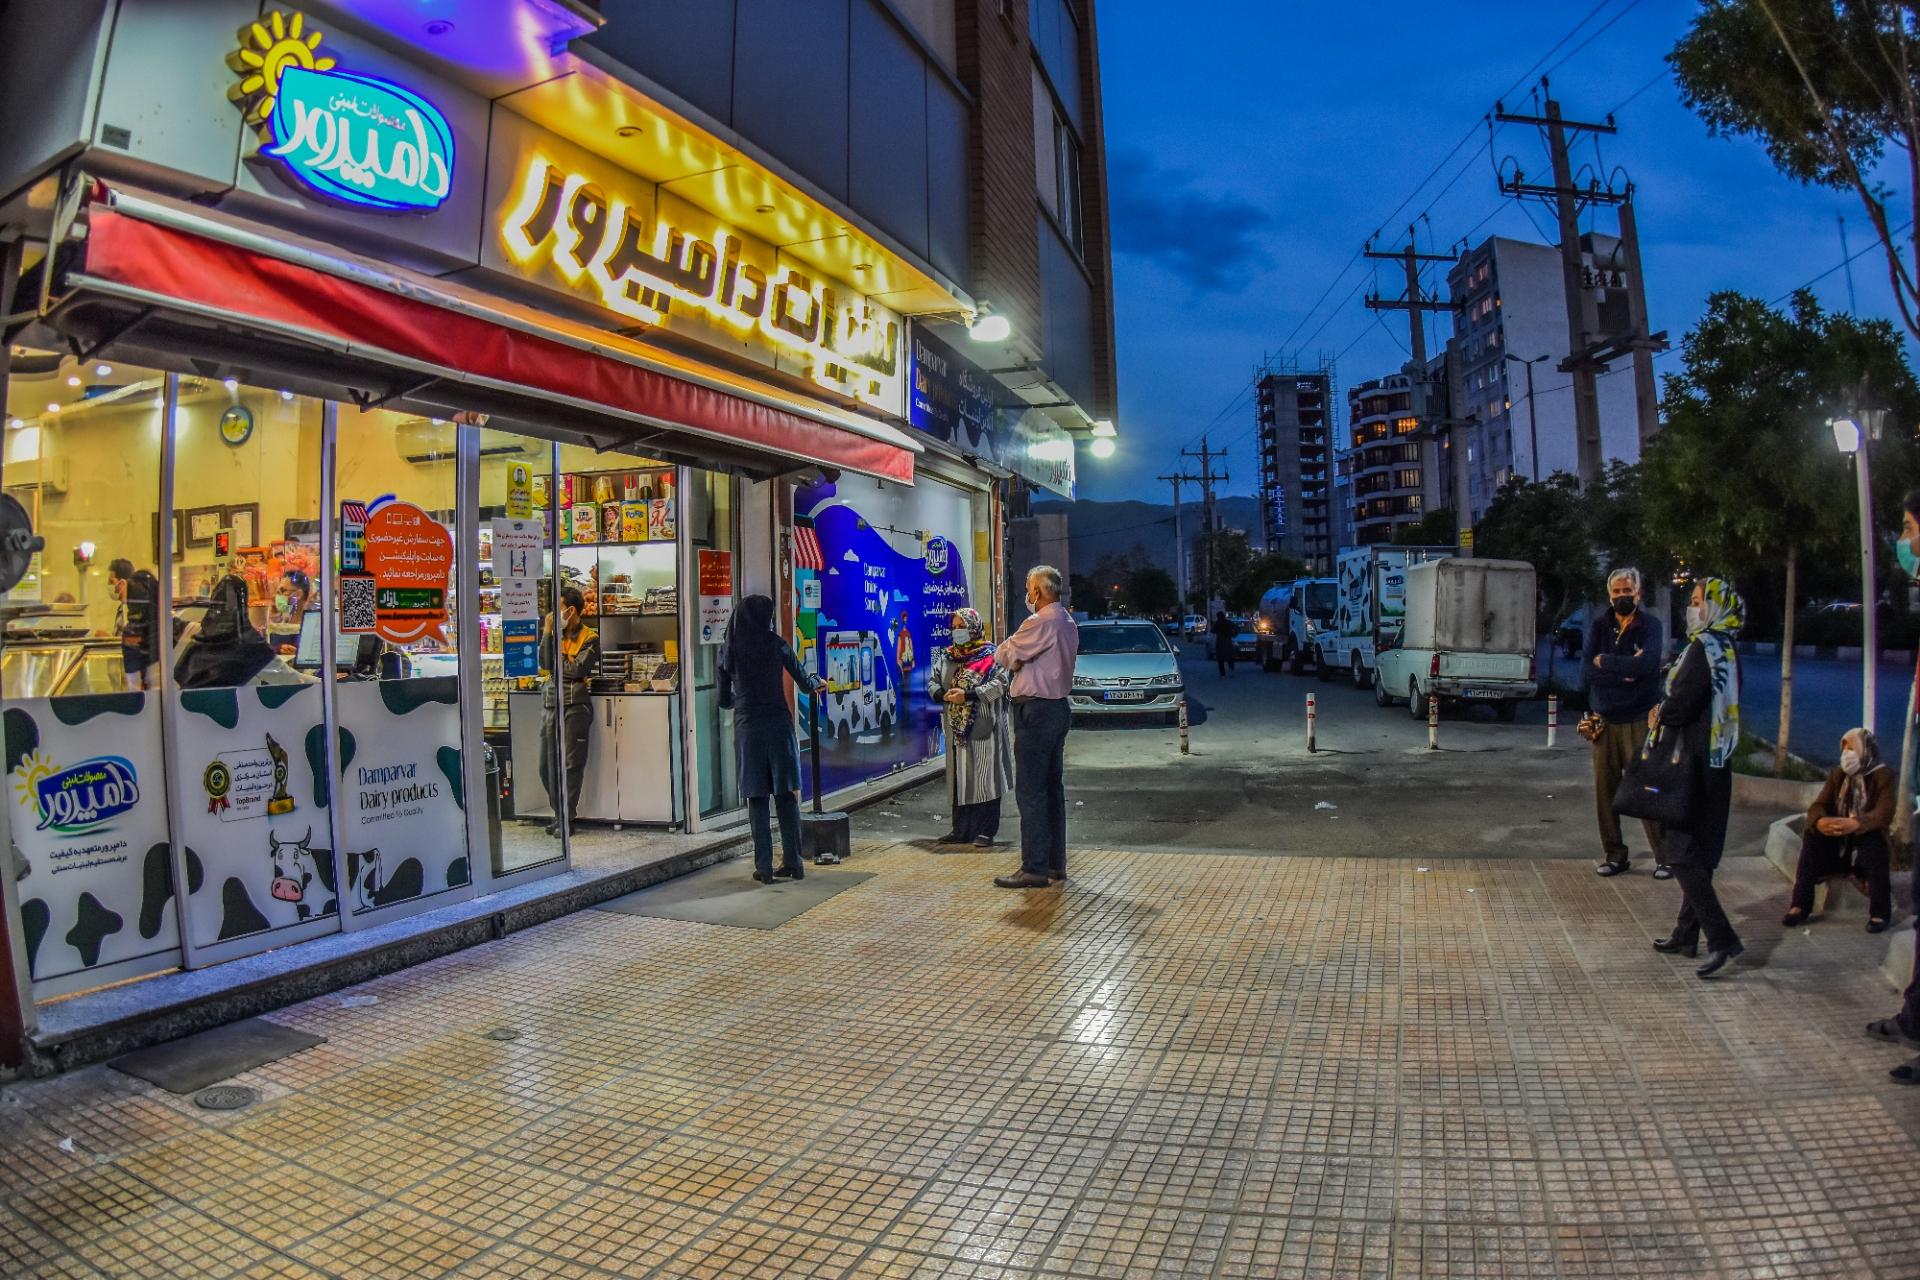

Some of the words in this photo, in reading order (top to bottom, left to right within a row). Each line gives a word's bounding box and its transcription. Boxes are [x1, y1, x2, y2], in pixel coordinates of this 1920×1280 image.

[328, 92, 358, 111] لبنی
[356, 99, 407, 132] محصولات
[269, 99, 450, 197] دامپرور
[520, 164, 768, 319] دامپرور
[771, 269, 899, 397] لبنیات
[403, 531, 428, 545] سفارش
[401, 567, 425, 580] مراجعه
[61, 773, 80, 790] لبنی
[78, 770, 107, 785] محصولات
[358, 762, 418, 786] Damparvar
[36, 761, 140, 831] دامپرور
[360, 789, 389, 810] Dairy
[391, 782, 439, 808] products
[49, 847, 73, 860] کیفیت
[100, 840, 128, 854] دامپرور
